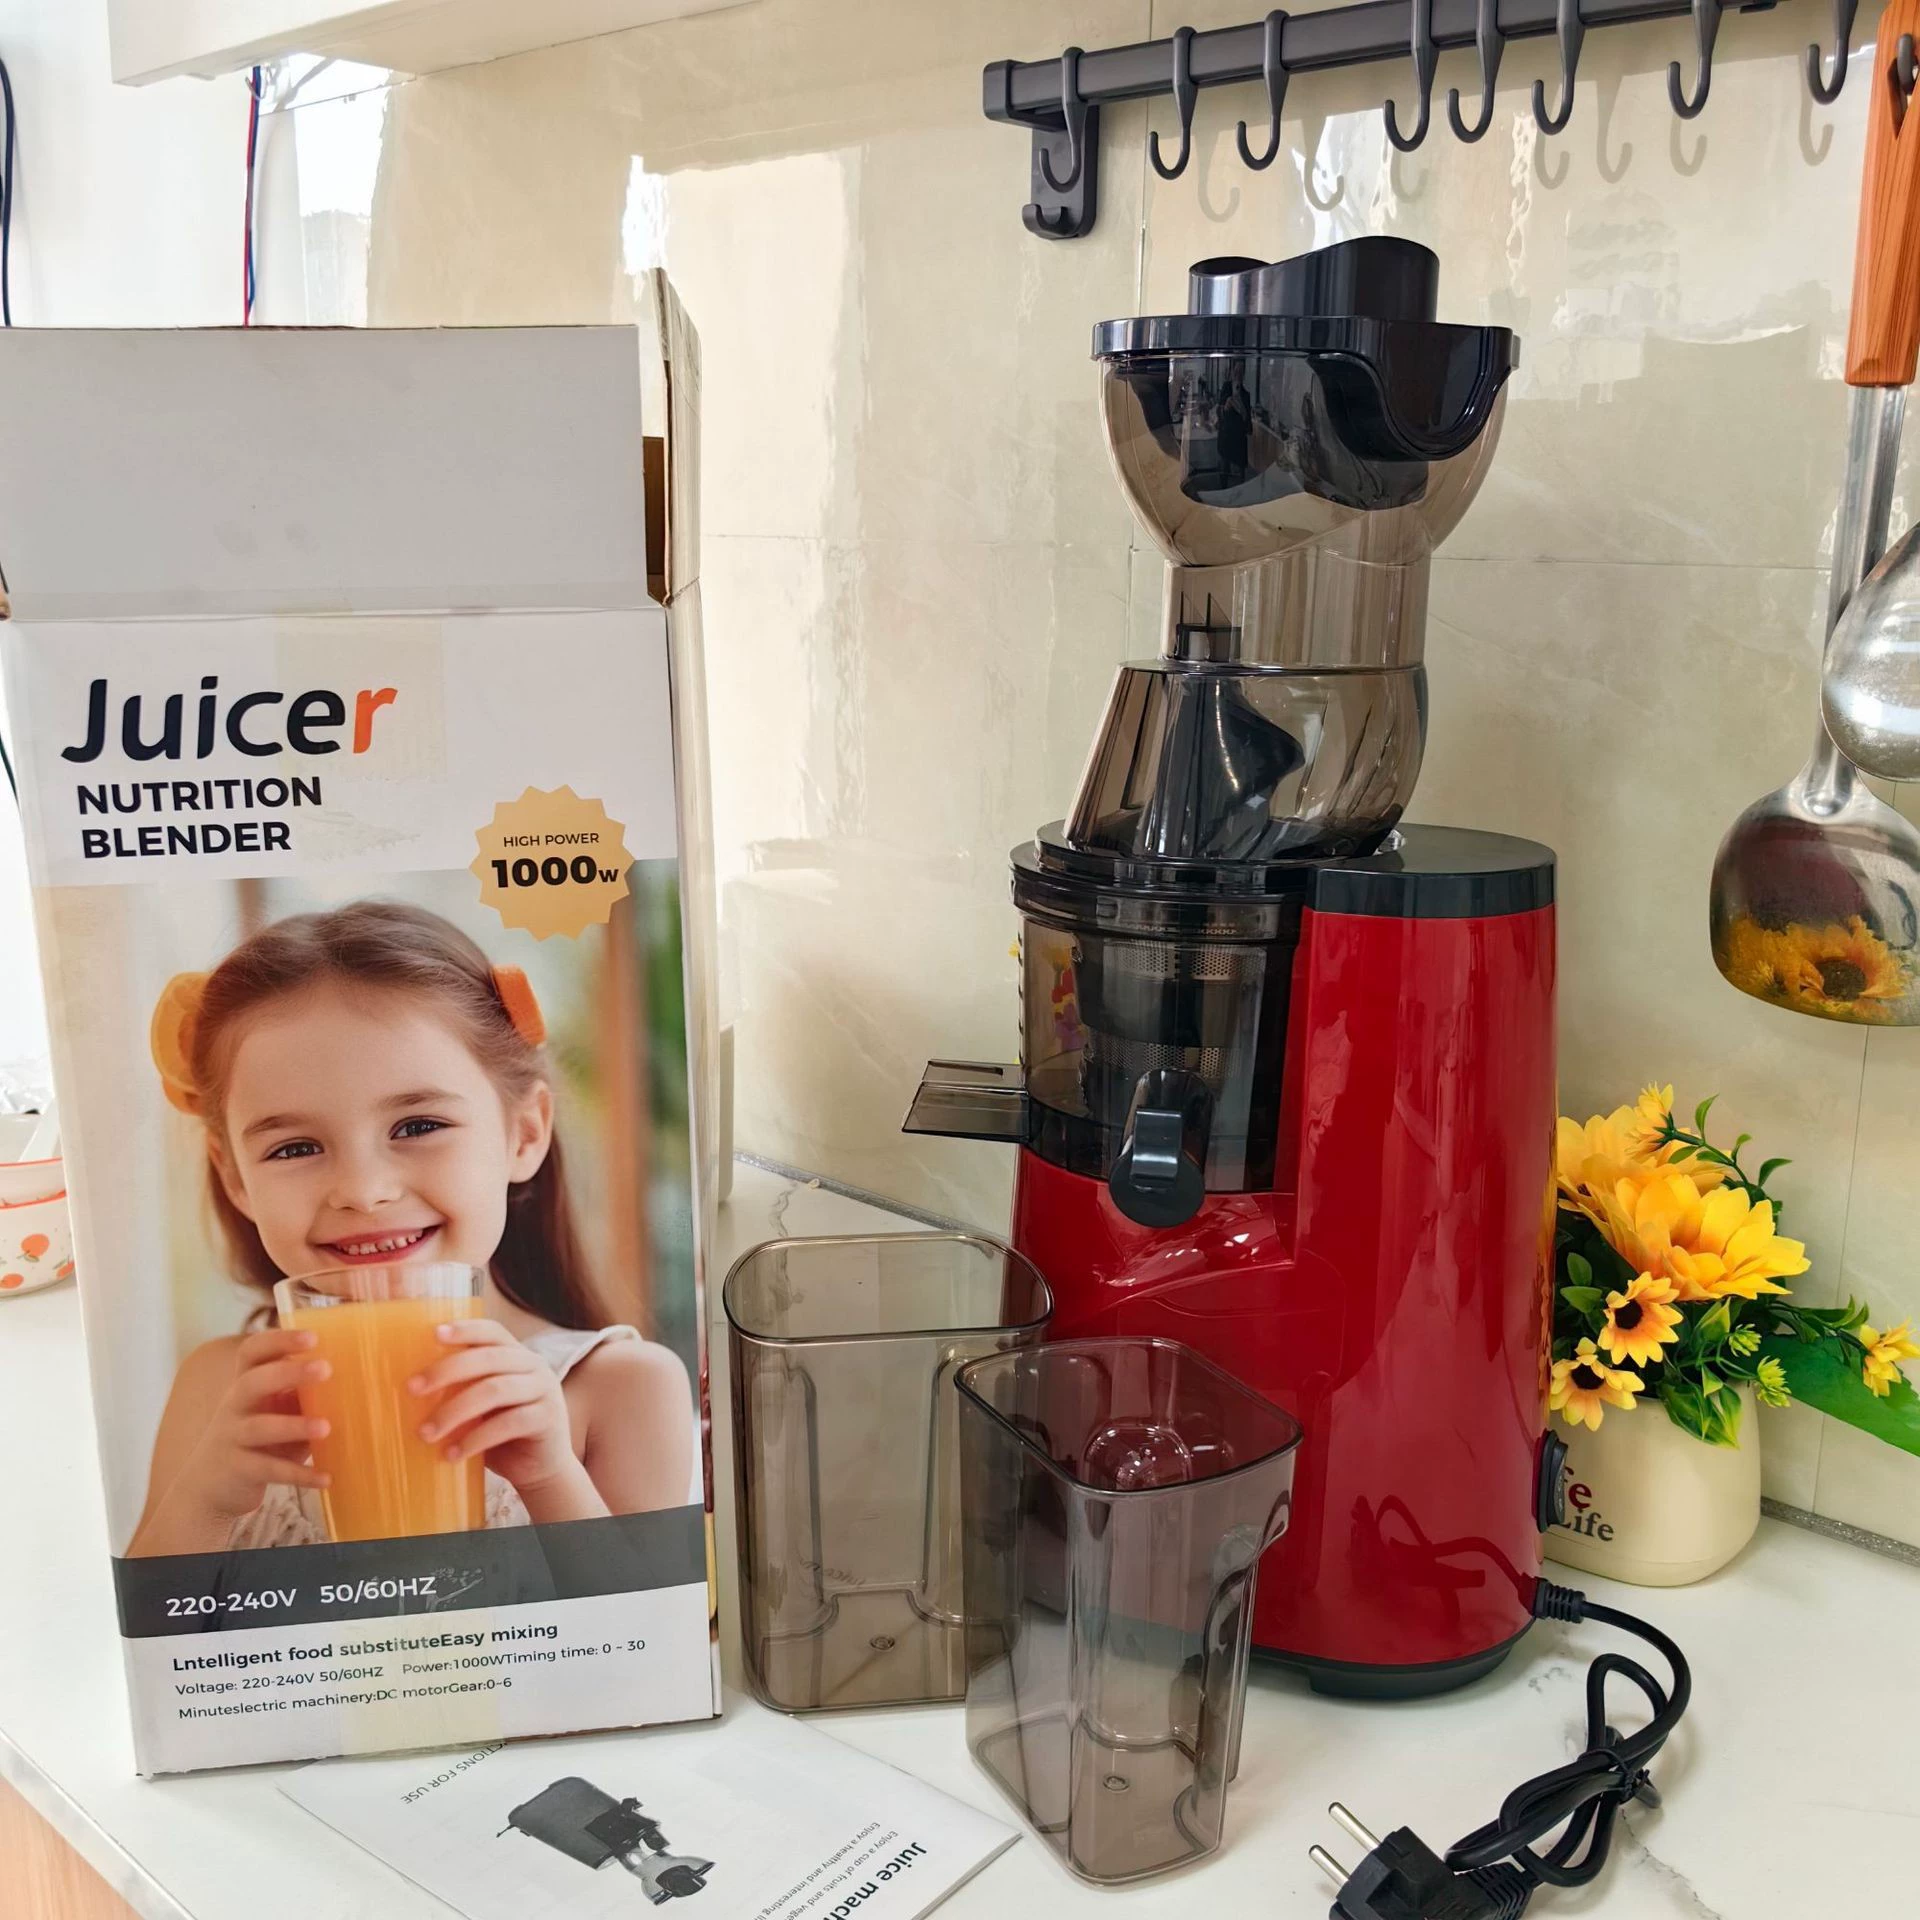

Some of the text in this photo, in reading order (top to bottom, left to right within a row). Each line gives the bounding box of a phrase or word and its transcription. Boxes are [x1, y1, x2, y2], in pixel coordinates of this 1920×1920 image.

[60, 675, 398, 763] Juicer
[77, 776, 322, 815] NUTRITION
[81, 821, 292, 859] BLENDER
[504, 832, 600, 848] HIGH POWER
[1559, 1508, 1614, 1542] ife
[165, 1576, 437, 1617] 220-240V 50/60HZ
[173, 1623, 558, 1671] Lntelligent food substituteEasy mixing
[175, 1681, 238, 1696] Voltage:
[242, 1672, 315, 1690] 220-240V
[319, 1666, 385, 1682] 50/60HZ
[561, 1646, 599, 1659] time:
[602, 1643, 611, 1655] 0
[627, 1640, 646, 1652] 30
[178, 1699, 288, 1720] Minuteslectric
[292, 1688, 398, 1709] machinery:DC
[427, 1769, 457, 1788] FOR
[400, 1786, 430, 1804] USE
[857, 1821, 881, 1841] Enjoy
[875, 1830, 899, 1850] Enjoy
[822, 1845, 854, 1870] healthy
[854, 1853, 870, 1867] cup
[875, 1841, 928, 1881] Juice
[806, 1868, 823, 1882] and
[823, 1873, 848, 1893] fruits
[762, 1880, 810, 1916] interesting
[807, 1891, 824, 1907] and
